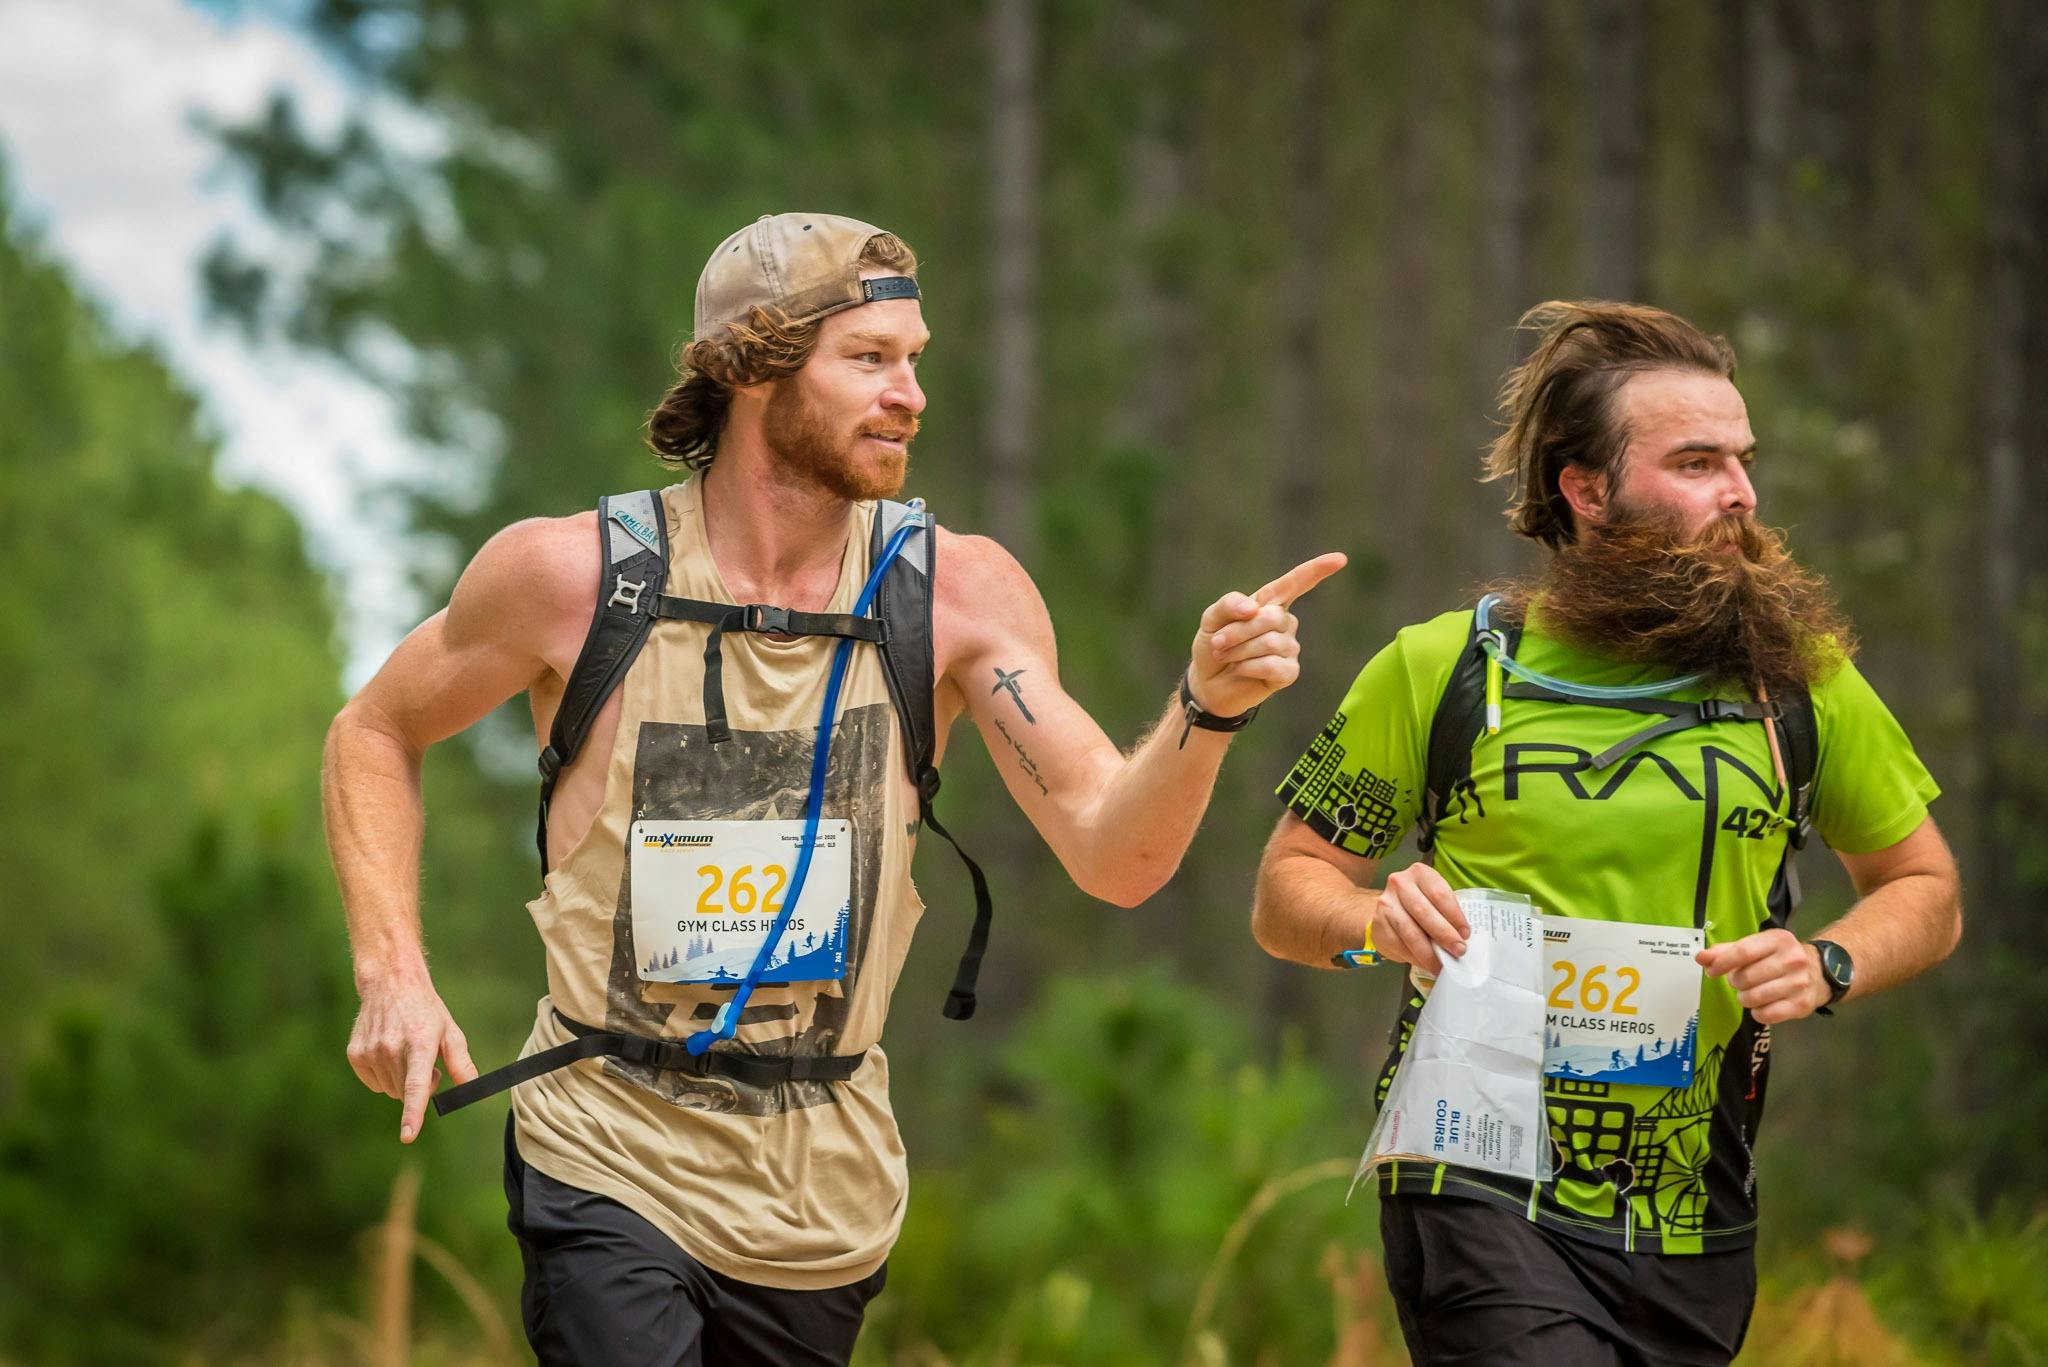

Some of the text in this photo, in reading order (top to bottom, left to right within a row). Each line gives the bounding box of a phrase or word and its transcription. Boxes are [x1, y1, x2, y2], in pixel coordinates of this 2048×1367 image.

[615, 510, 658, 546] CAMELBAK
[696, 864, 787, 914] 262
[677, 918, 805, 932] GYM CLASS HEOS
[1548, 960, 1641, 1015] 262
[1561, 1015, 1606, 1031] CLASS
[1610, 1020, 1655, 1035] HEROS
[1434, 1099, 1447, 1153] COURSE
[1449, 1110, 1461, 1145] BLUE
[1487, 1121, 1495, 1156] Numbers
[1494, 1119, 1504, 1162] Emergency
